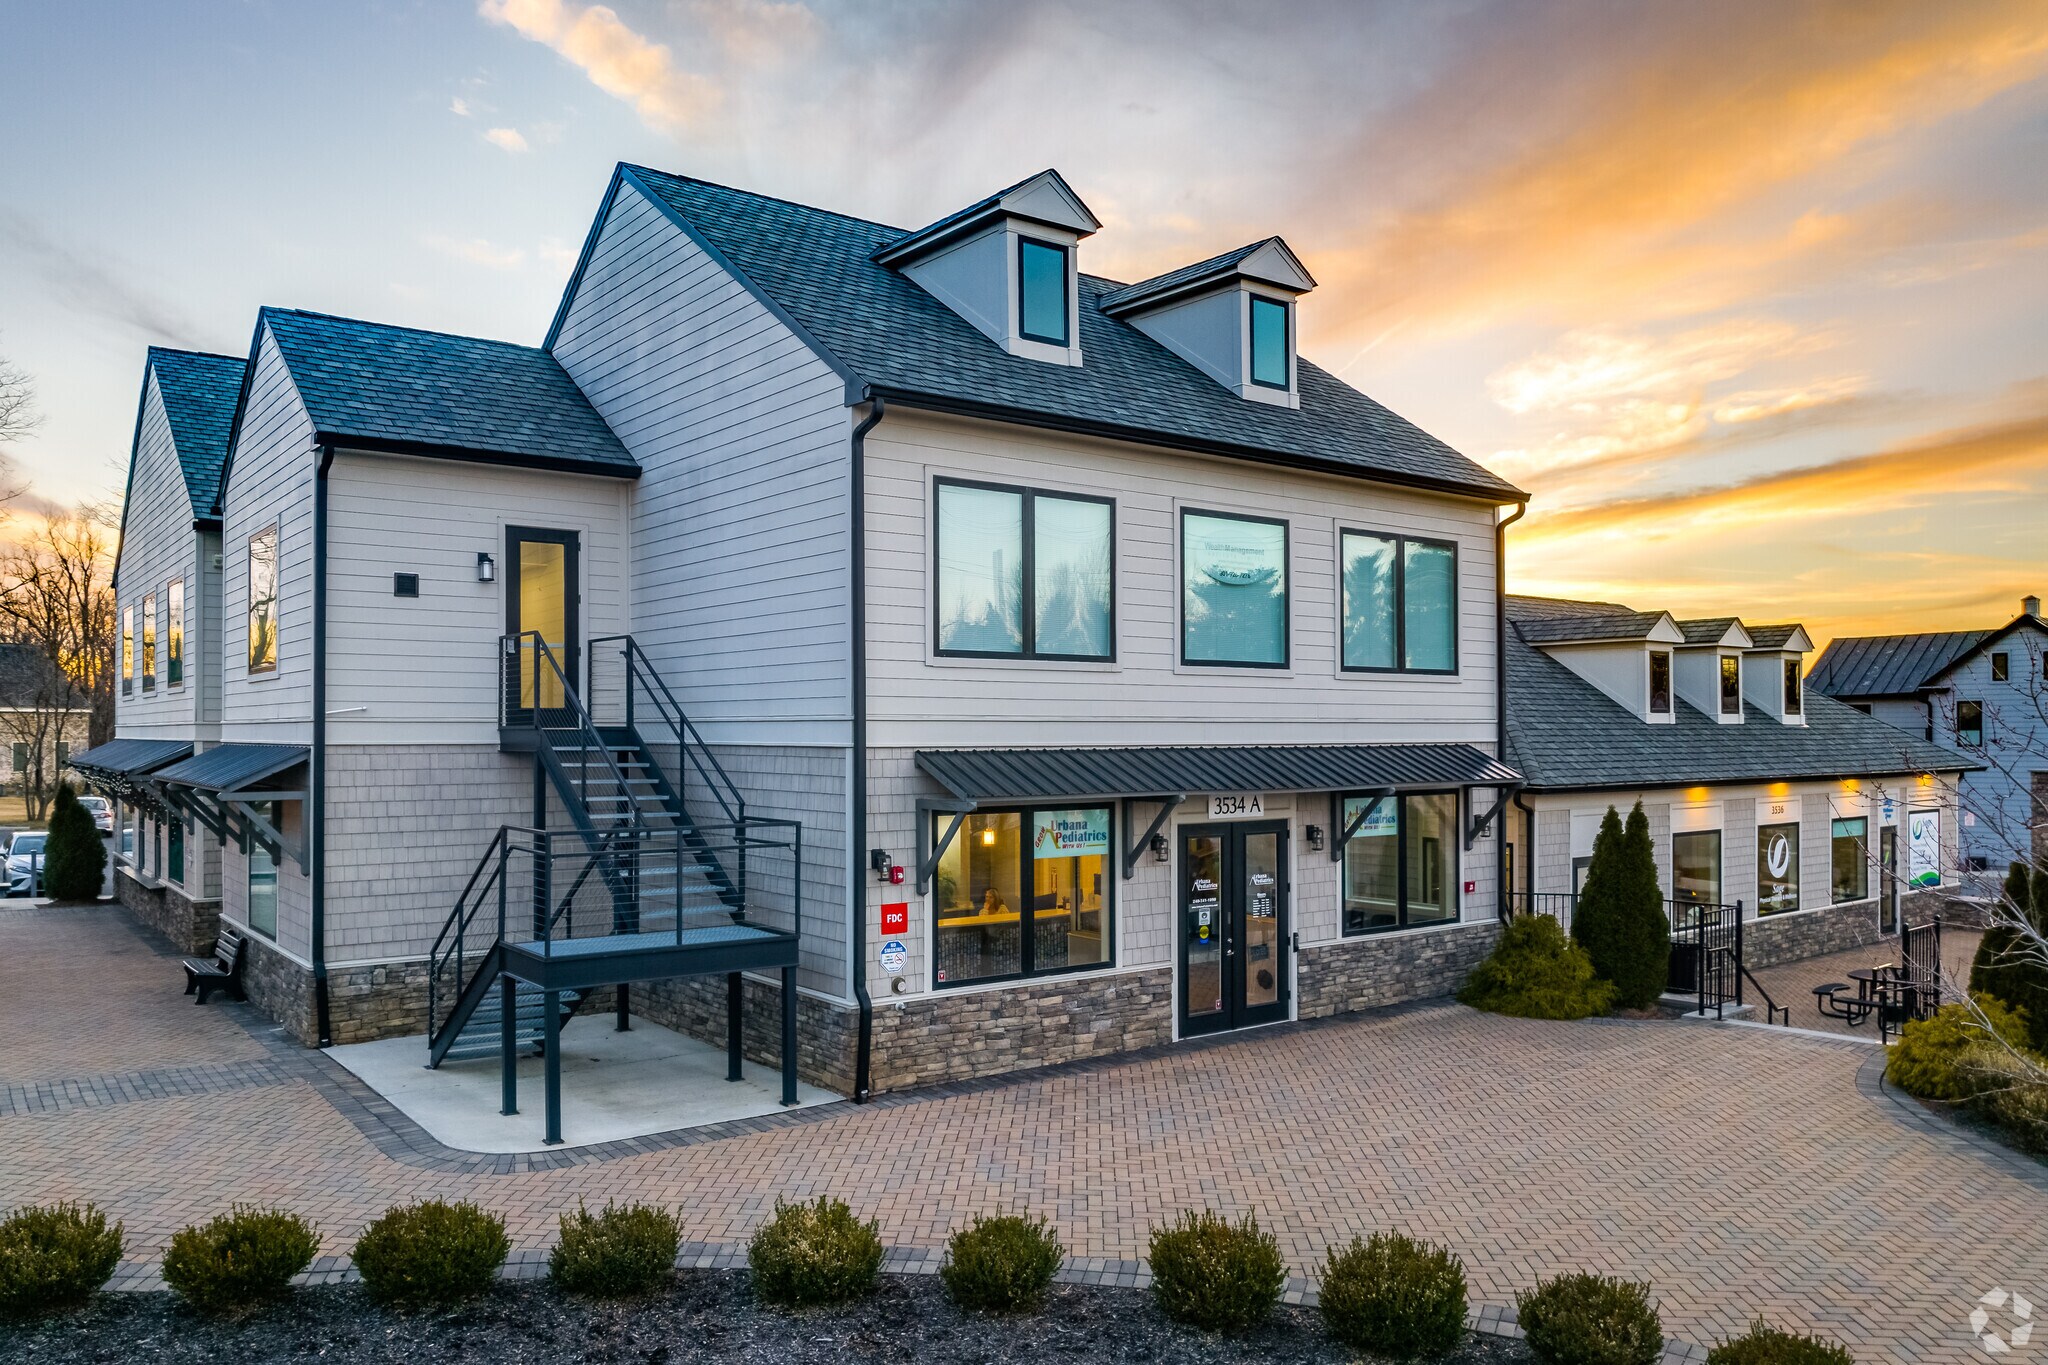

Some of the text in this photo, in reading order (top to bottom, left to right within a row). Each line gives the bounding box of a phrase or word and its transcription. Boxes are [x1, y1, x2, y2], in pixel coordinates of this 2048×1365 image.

[1214, 794, 1261, 814] 3534 A
[1771, 805, 1784, 814] 3536
[1051, 820, 1088, 831] Urbana
[1055, 829, 1107, 844] Pediatrics
[886, 913, 903, 923] FDC
